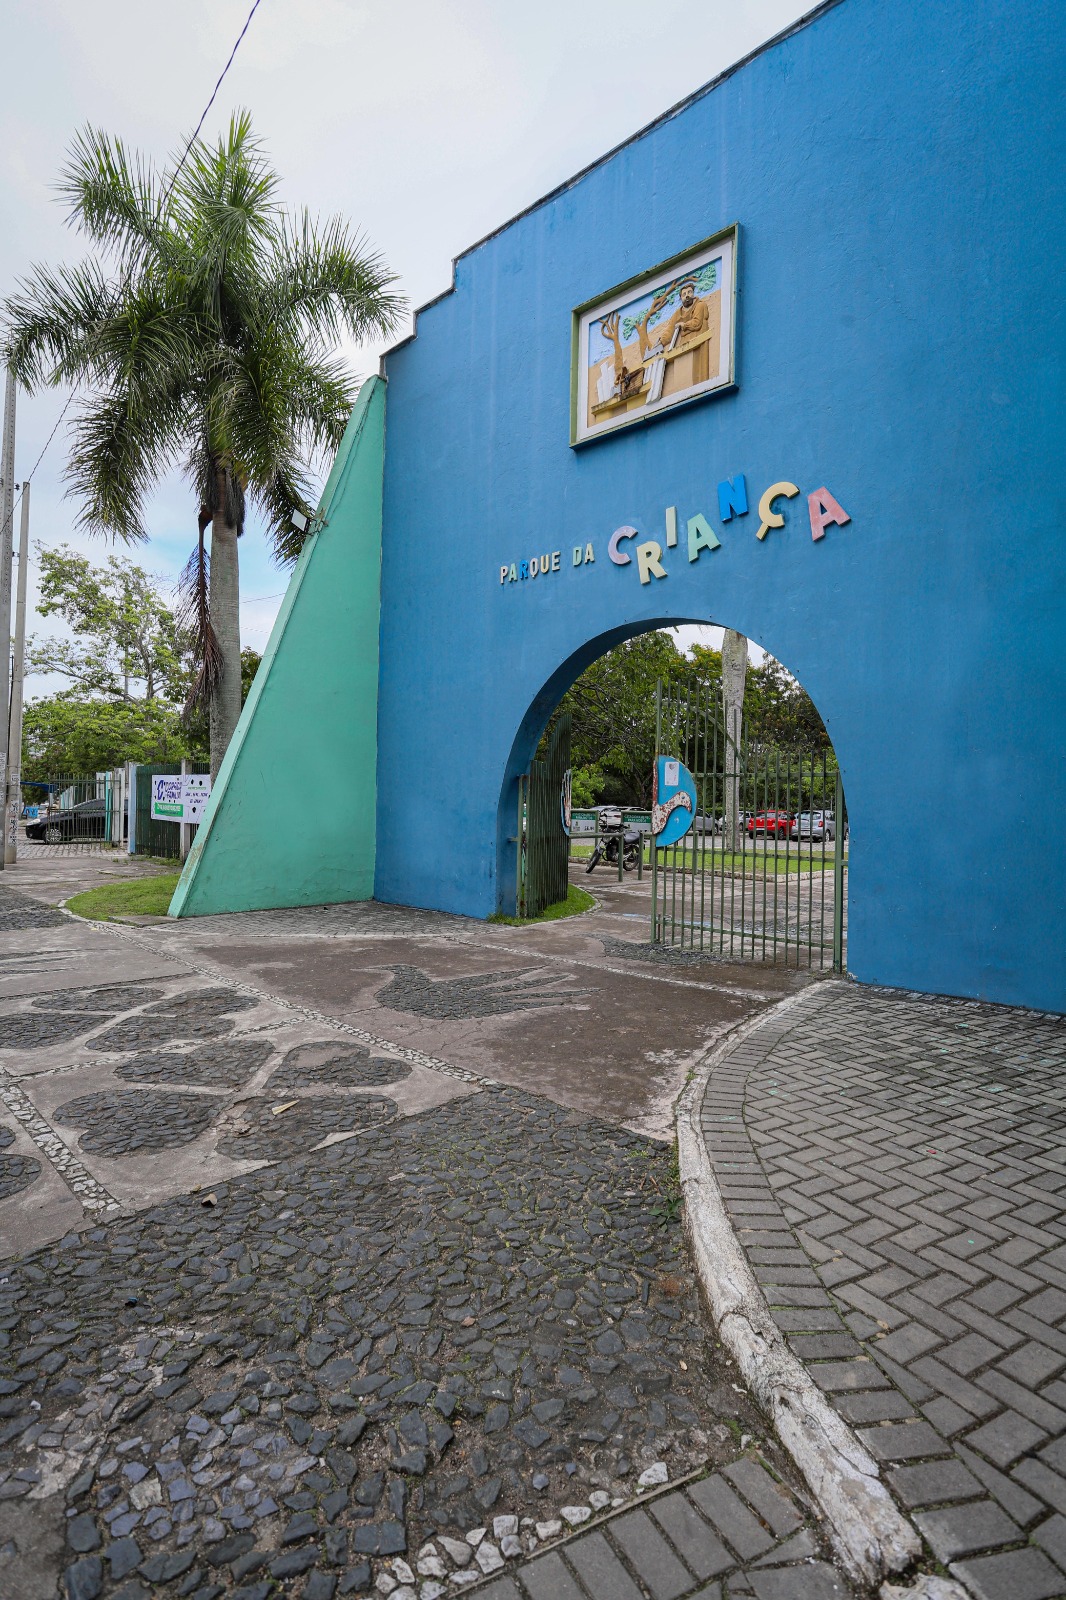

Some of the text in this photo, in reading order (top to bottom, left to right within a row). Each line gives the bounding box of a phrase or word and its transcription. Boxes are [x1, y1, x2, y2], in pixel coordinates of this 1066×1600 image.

[500, 473, 852, 585] PARQUE DA CRIANÇA
